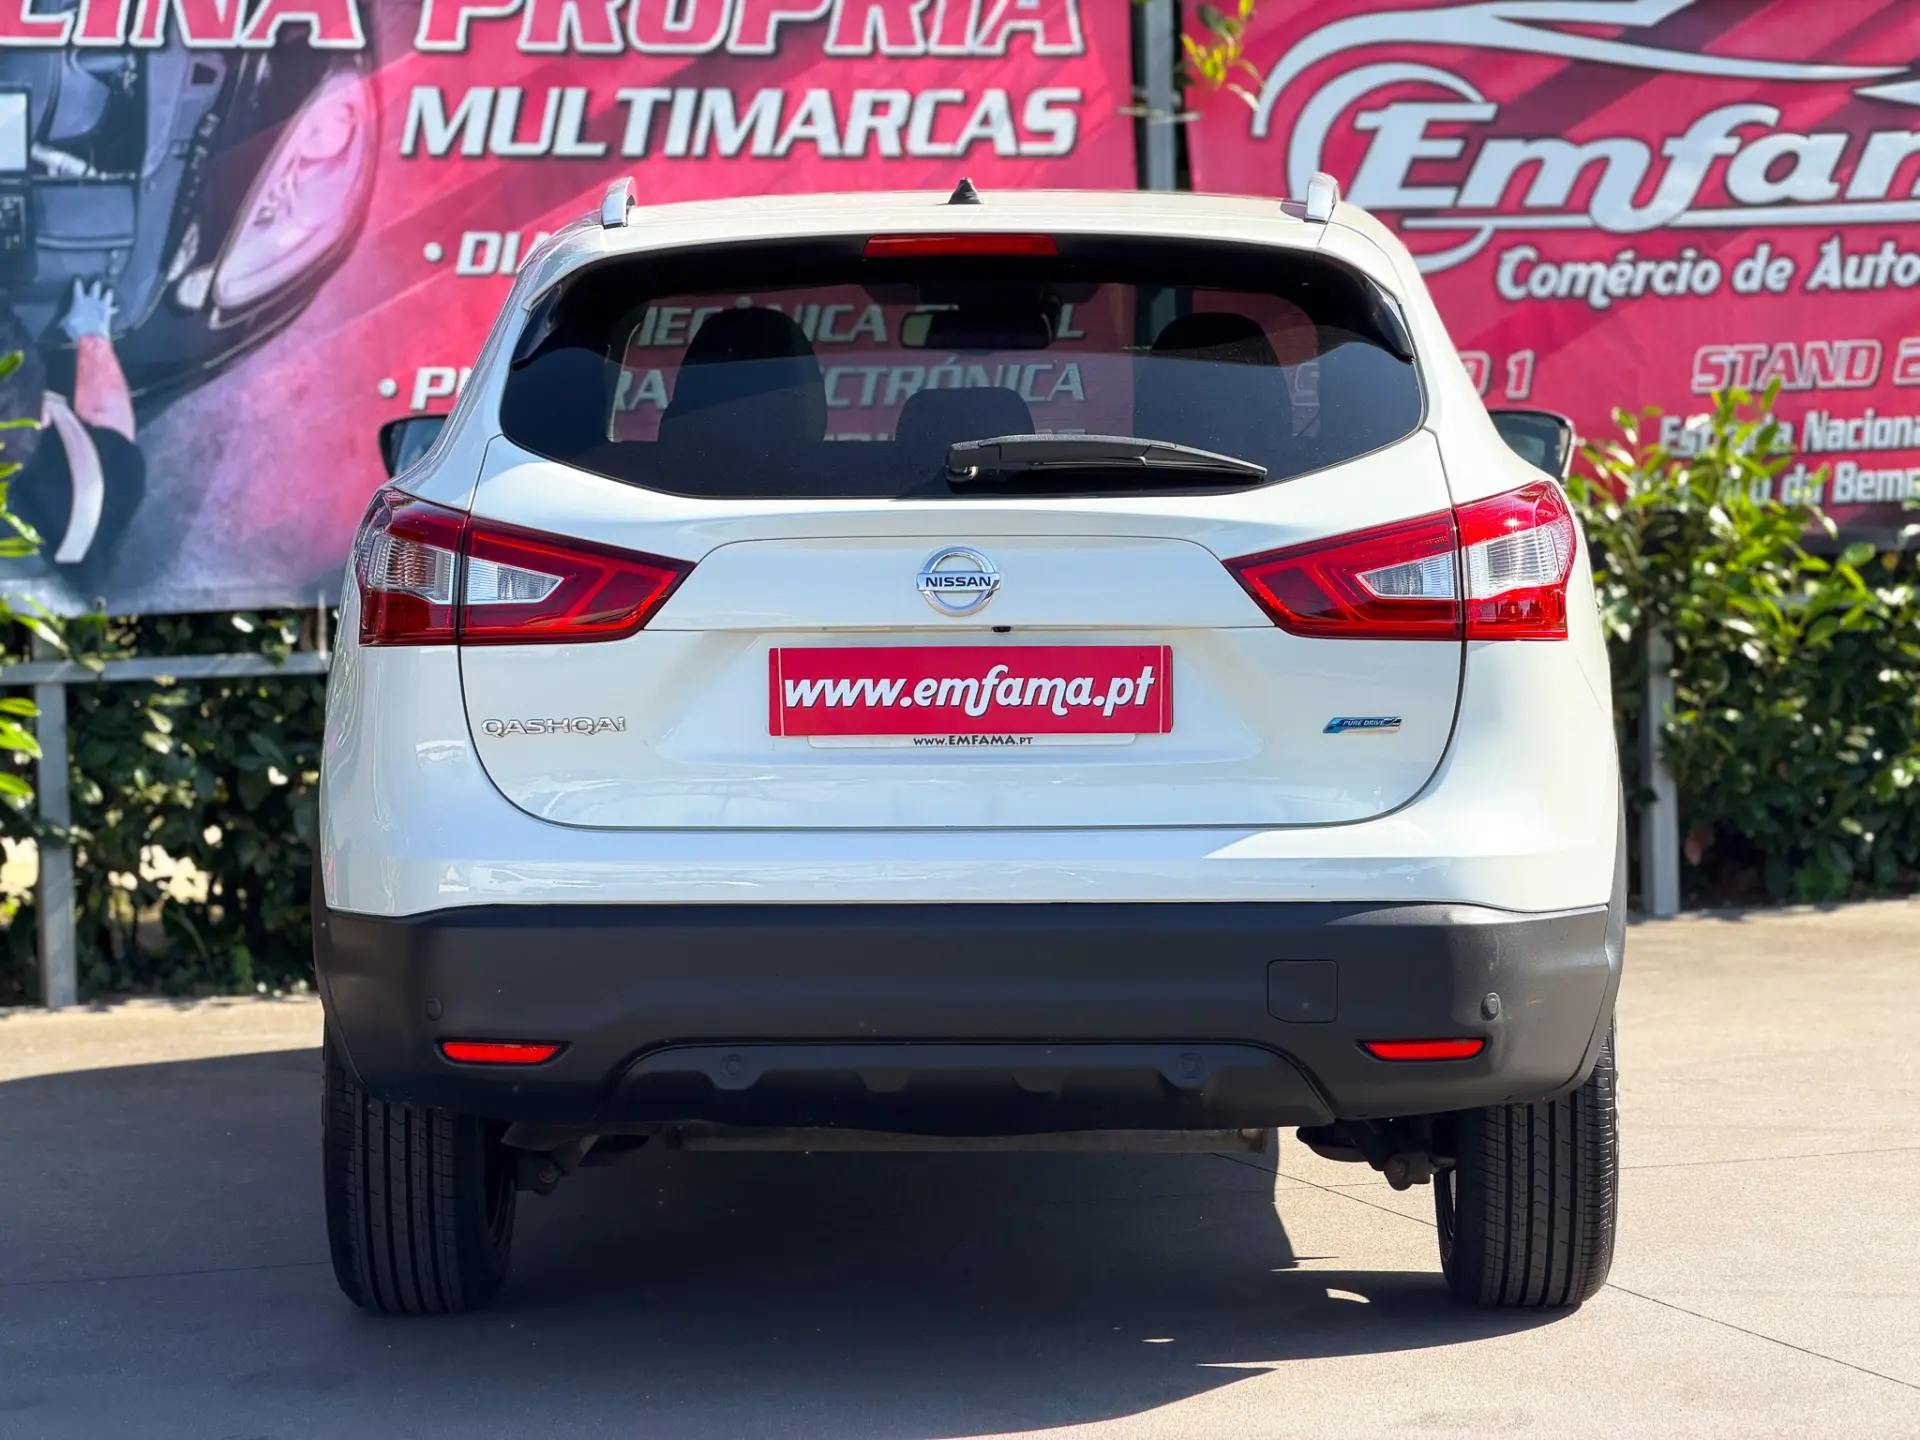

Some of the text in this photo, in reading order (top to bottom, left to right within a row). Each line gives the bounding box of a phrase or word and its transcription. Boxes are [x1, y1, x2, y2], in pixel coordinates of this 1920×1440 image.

[401, 87, 1081, 157] MULTIMARCAS
[1497, 245, 1721, 307] Comércio
[1732, 244, 1794, 293] de
[1506, 349, 1535, 399] 1
[1691, 341, 1883, 393] STAND
[925, 576, 991, 587] NISSAN
[784, 665, 1155, 717] www.emfama.pt
[481, 716, 626, 738] QASHQAI
